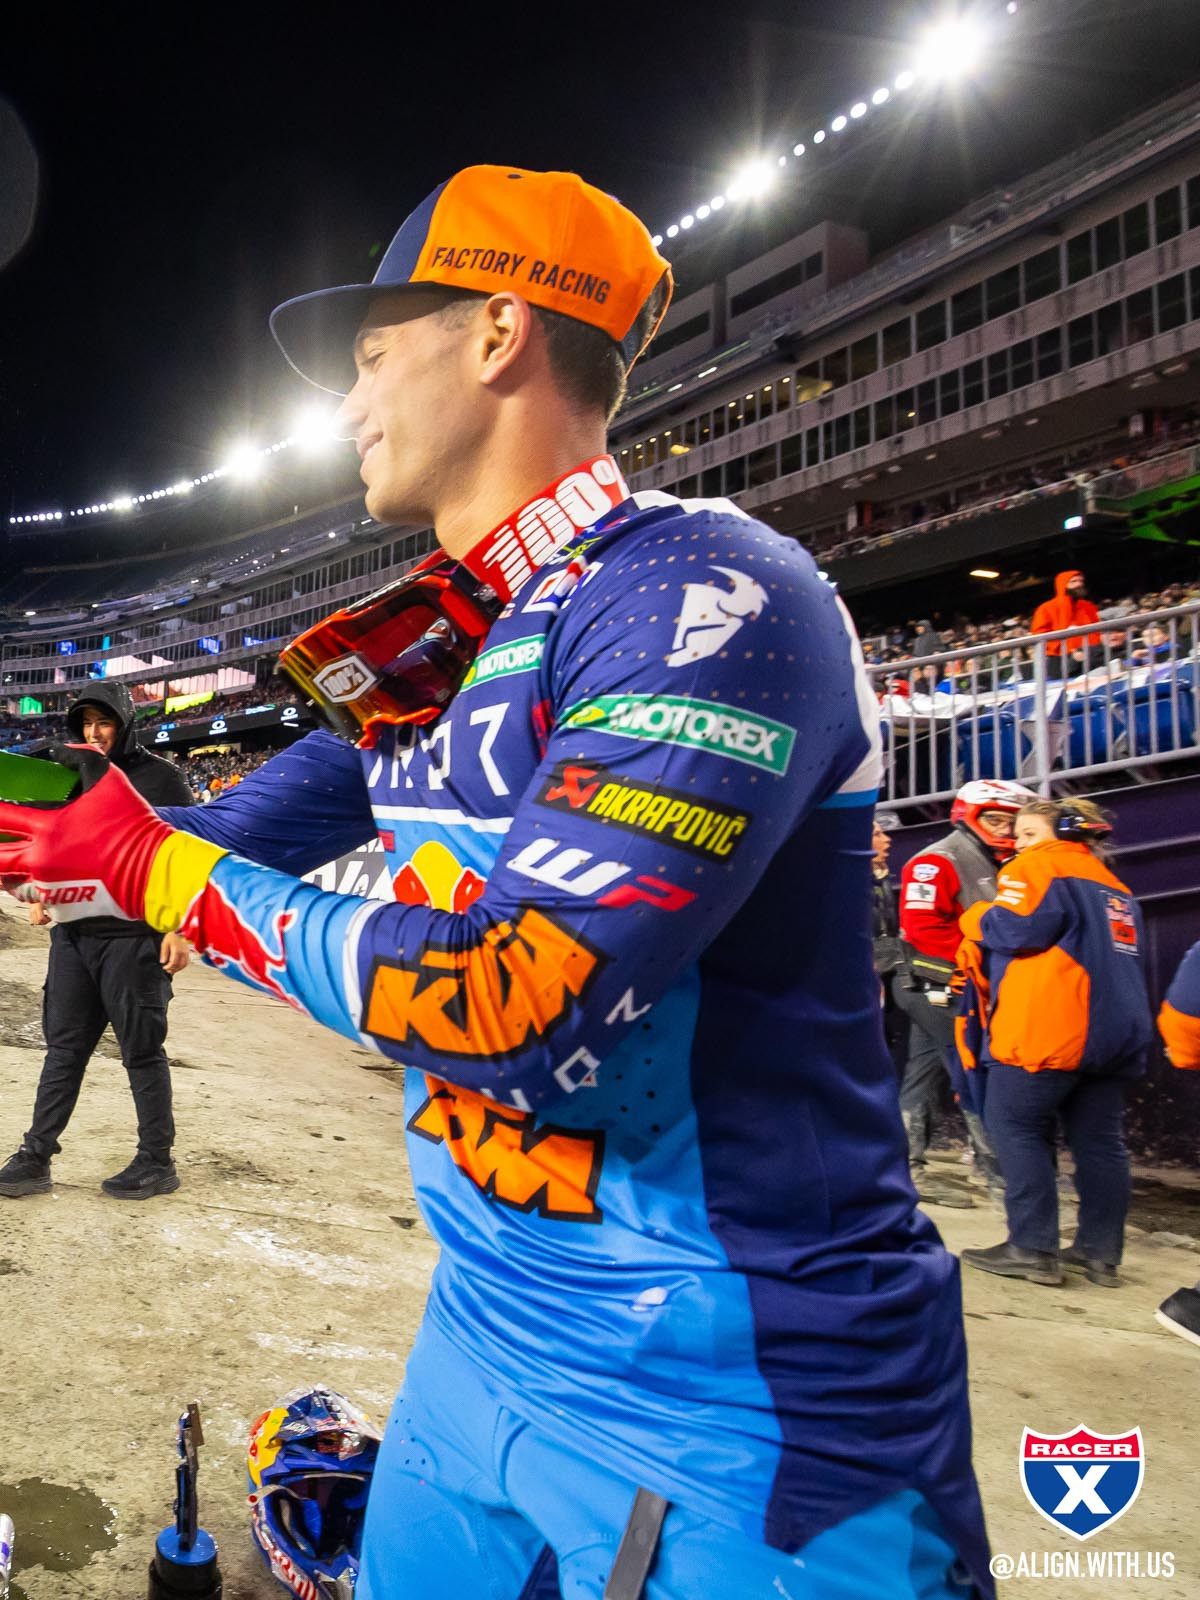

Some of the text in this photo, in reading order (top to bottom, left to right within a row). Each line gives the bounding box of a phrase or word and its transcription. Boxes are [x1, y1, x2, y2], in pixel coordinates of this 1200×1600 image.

[432, 246, 611, 304] FACTORY RACING
[322, 664, 365, 697] 100%
[608, 702, 780, 762] MOTOREX
[35, 884, 98, 906] THOR
[506, 838, 698, 912] WP
